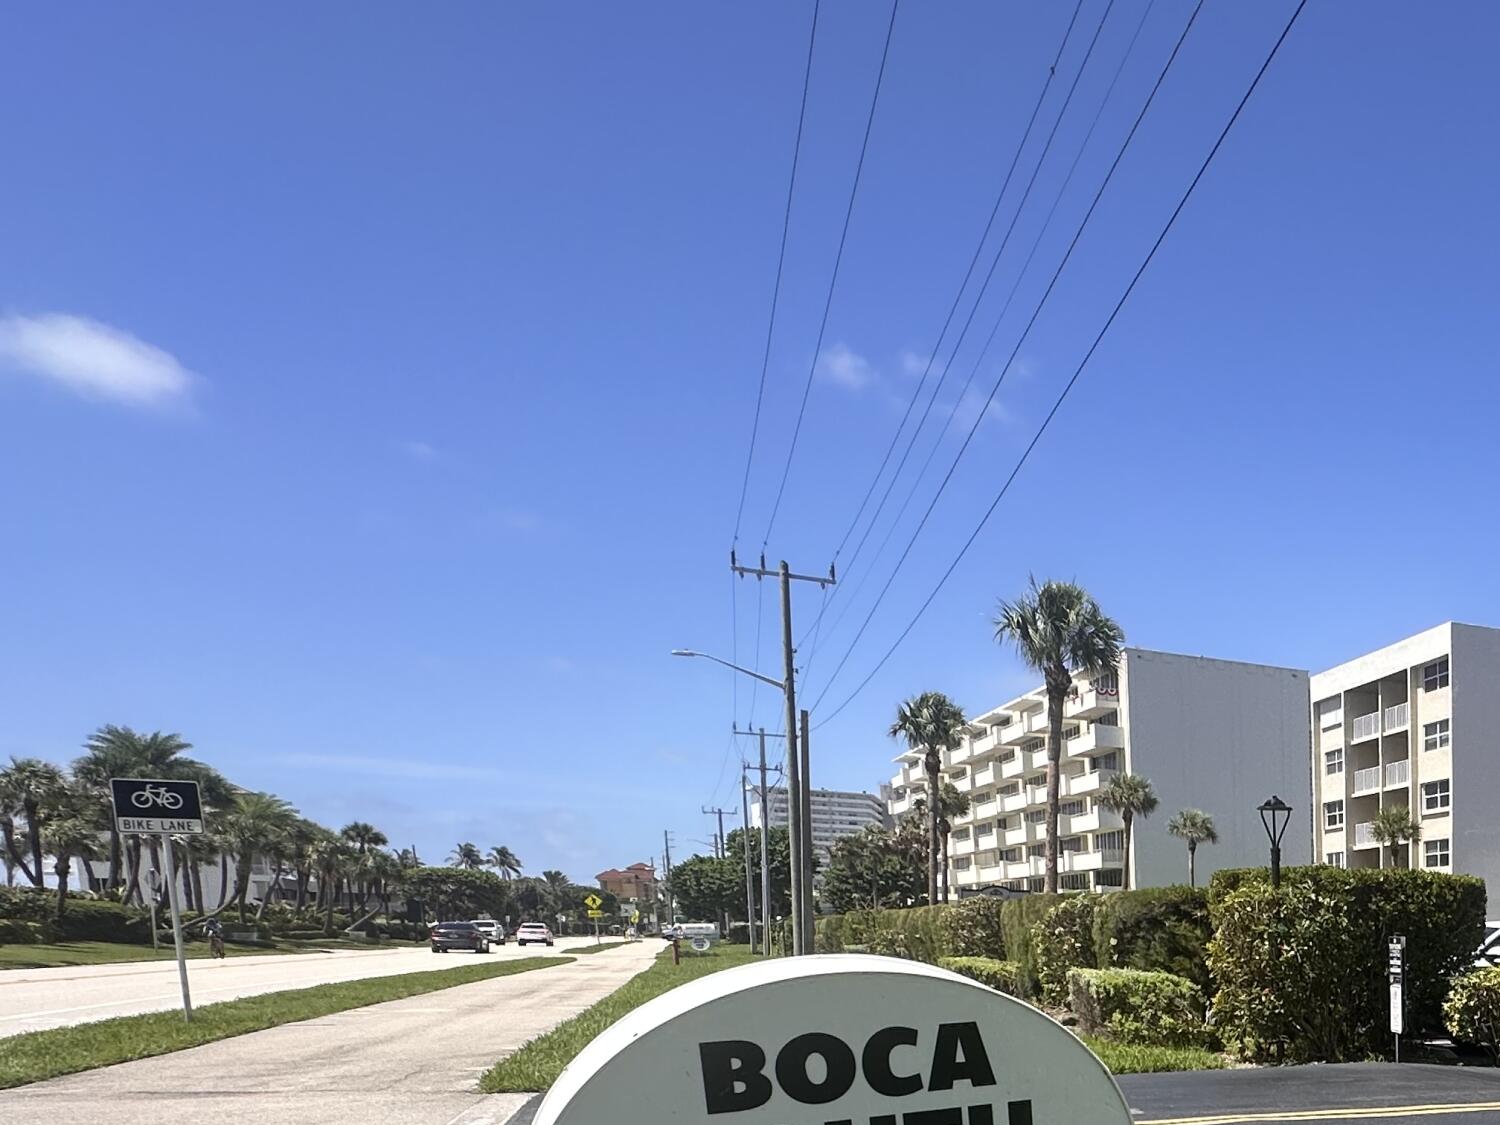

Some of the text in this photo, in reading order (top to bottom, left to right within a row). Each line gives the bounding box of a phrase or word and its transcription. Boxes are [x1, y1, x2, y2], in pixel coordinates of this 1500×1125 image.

[123, 819, 194, 831] BIKE LANE
[698, 1021, 998, 1115] BOCA
